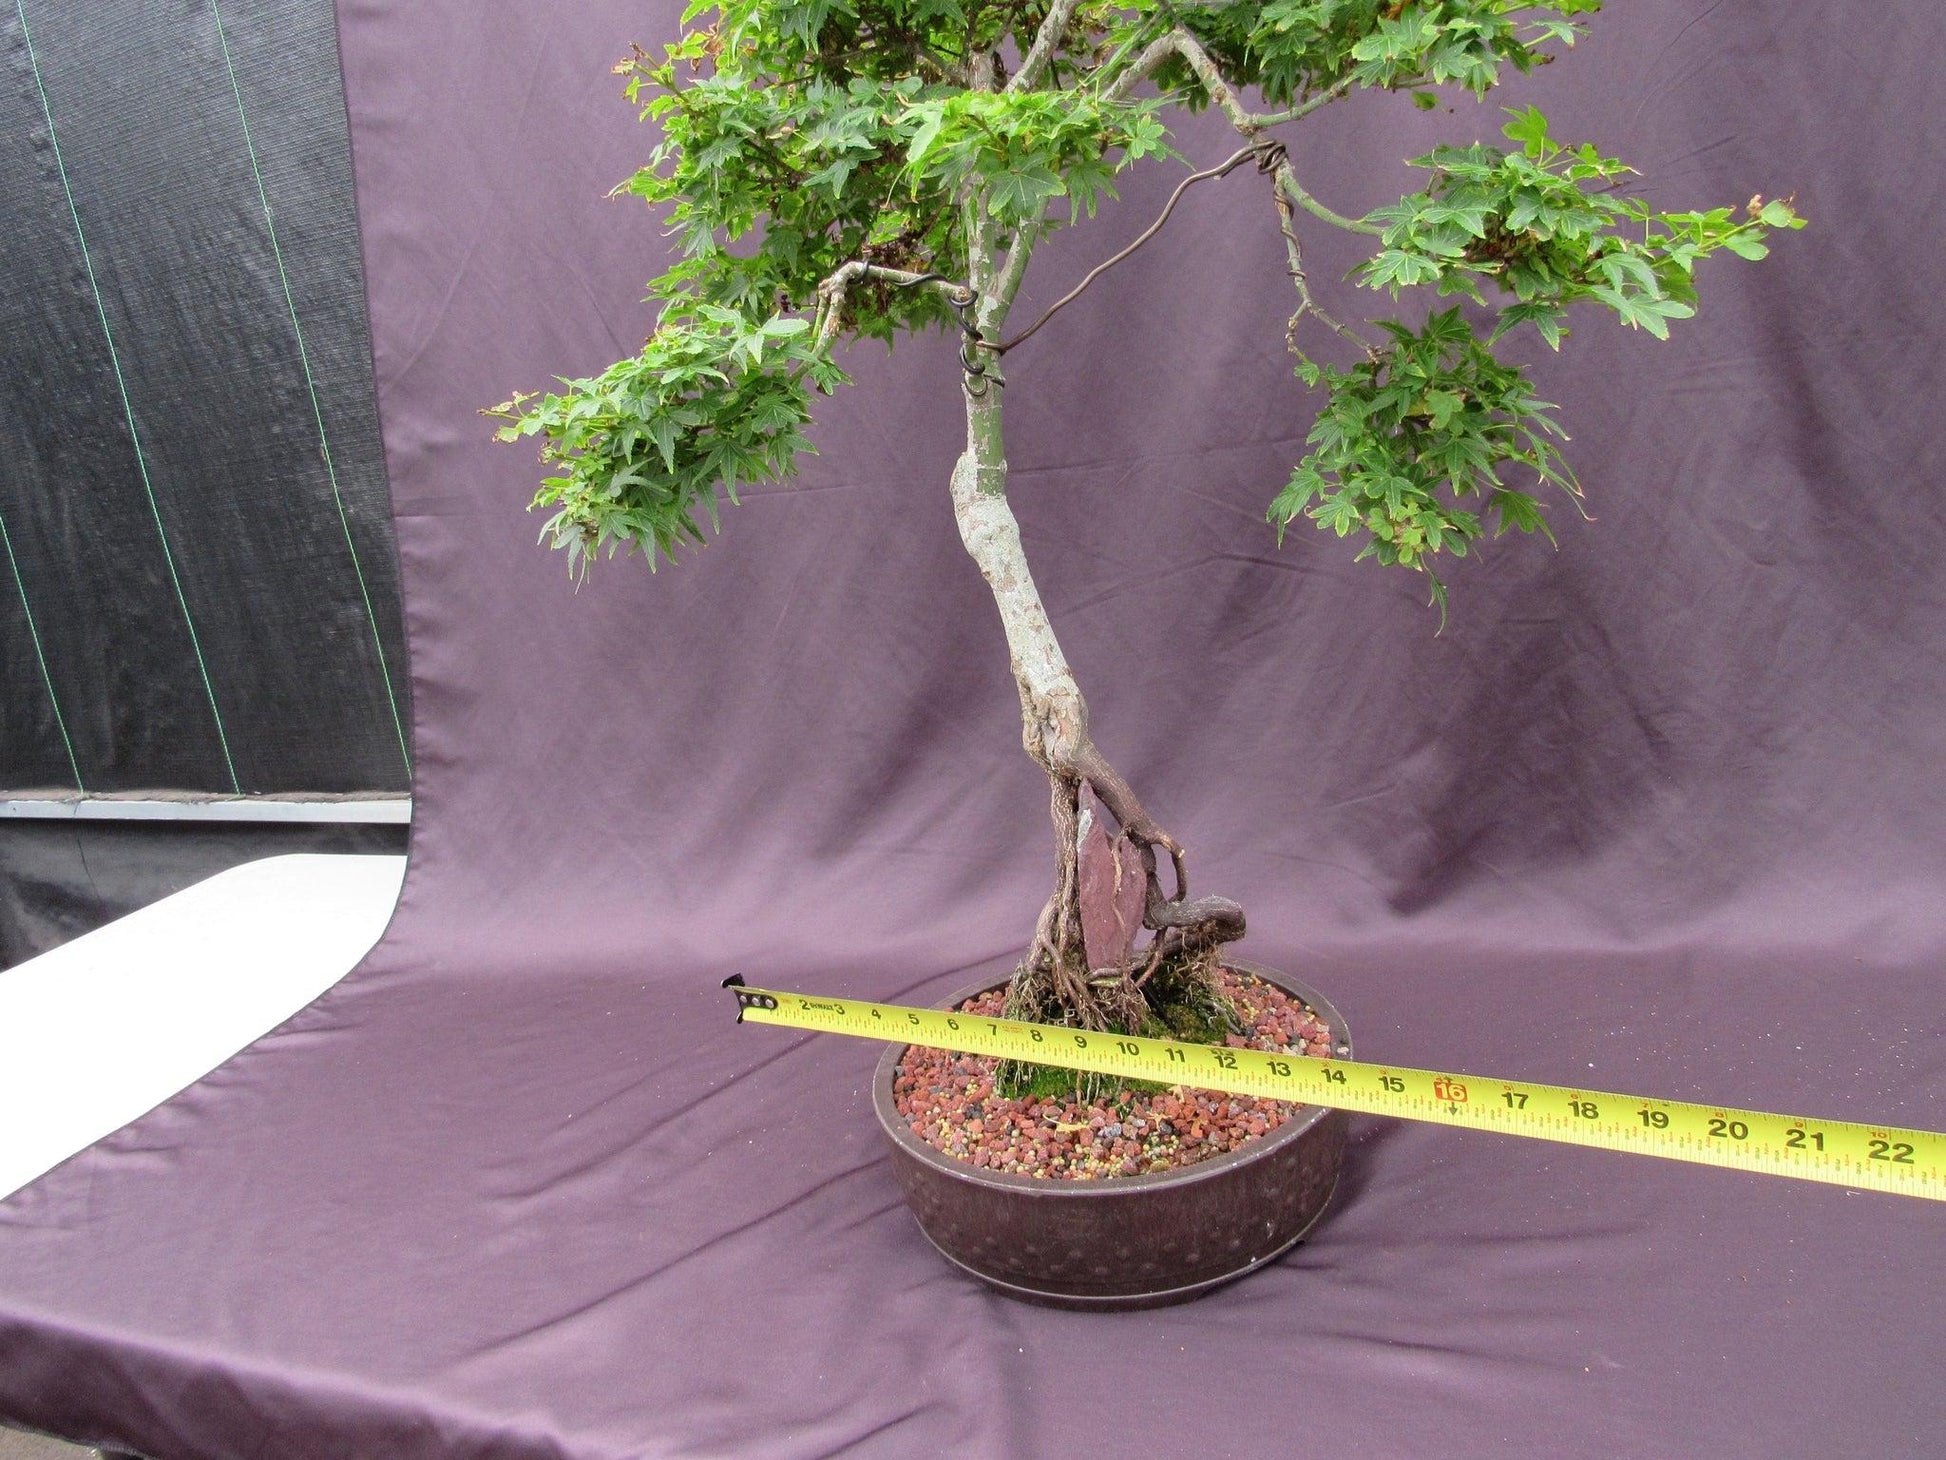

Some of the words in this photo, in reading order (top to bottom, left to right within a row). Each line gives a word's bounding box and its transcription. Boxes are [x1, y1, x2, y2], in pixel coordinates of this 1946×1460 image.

[799, 999, 810, 1010] 2
[834, 1003, 845, 1015] 3
[871, 1009, 881, 1019] 4
[908, 1013, 920, 1025] 5
[947, 1018, 959, 1030] 6
[987, 1024, 997, 1035] 7
[1030, 1029, 1043, 1042] 8
[1074, 1035, 1087, 1048] 9
[1116, 1041, 1139, 1055] 10
[1165, 1048, 1185, 1062] 11
[1214, 1055, 1238, 1070] 12
[1266, 1061, 1291, 1076] 13
[1321, 1069, 1347, 1084] 14
[1378, 1076, 1405, 1092] 15
[1436, 1083, 1466, 1101] 16
[1501, 1092, 1528, 1109] 17
[1568, 1101, 1599, 1119] 18
[1637, 1110, 1669, 1129] 19
[1708, 1119, 1748, 1140] 20
[1786, 1129, 1823, 1151] 21
[1868, 1140, 1914, 1164] 22
